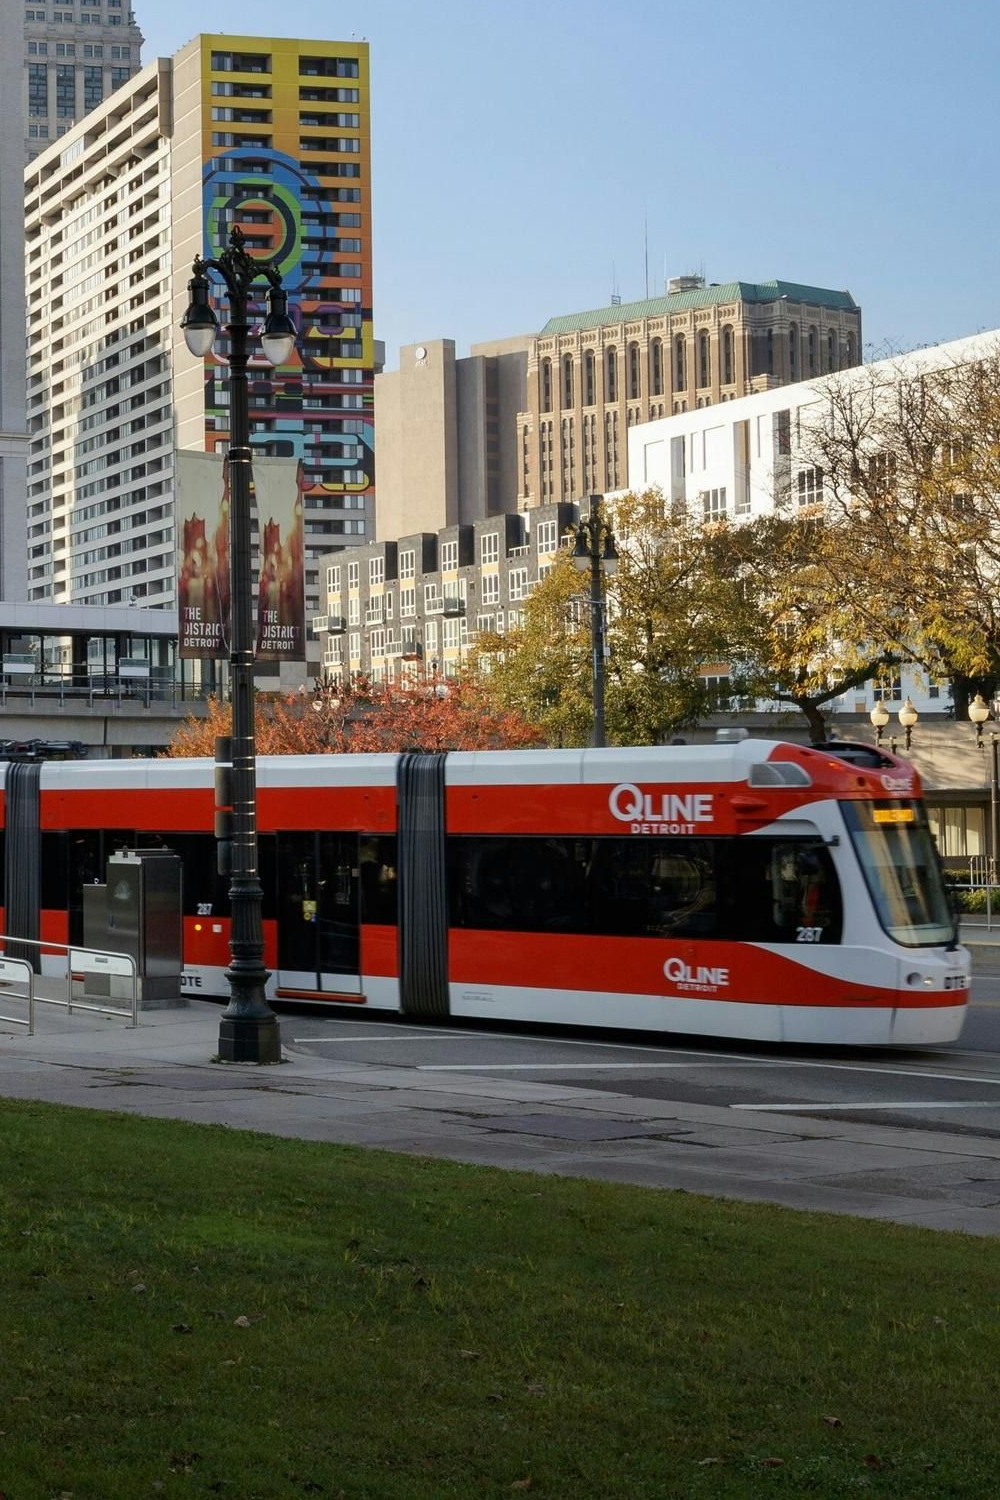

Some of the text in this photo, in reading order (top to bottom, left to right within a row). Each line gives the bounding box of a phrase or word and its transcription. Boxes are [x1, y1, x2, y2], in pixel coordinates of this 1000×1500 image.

[184, 607, 201, 620] THE
[263, 610, 278, 623] THE
[184, 638, 220, 648] DETROIT
[261, 640, 295, 650] DETROIT
[608, 783, 714, 822] QLINE
[631, 823, 696, 834] DETROIT
[795, 926, 824, 942] 287
[663, 957, 729, 986] QLINE
